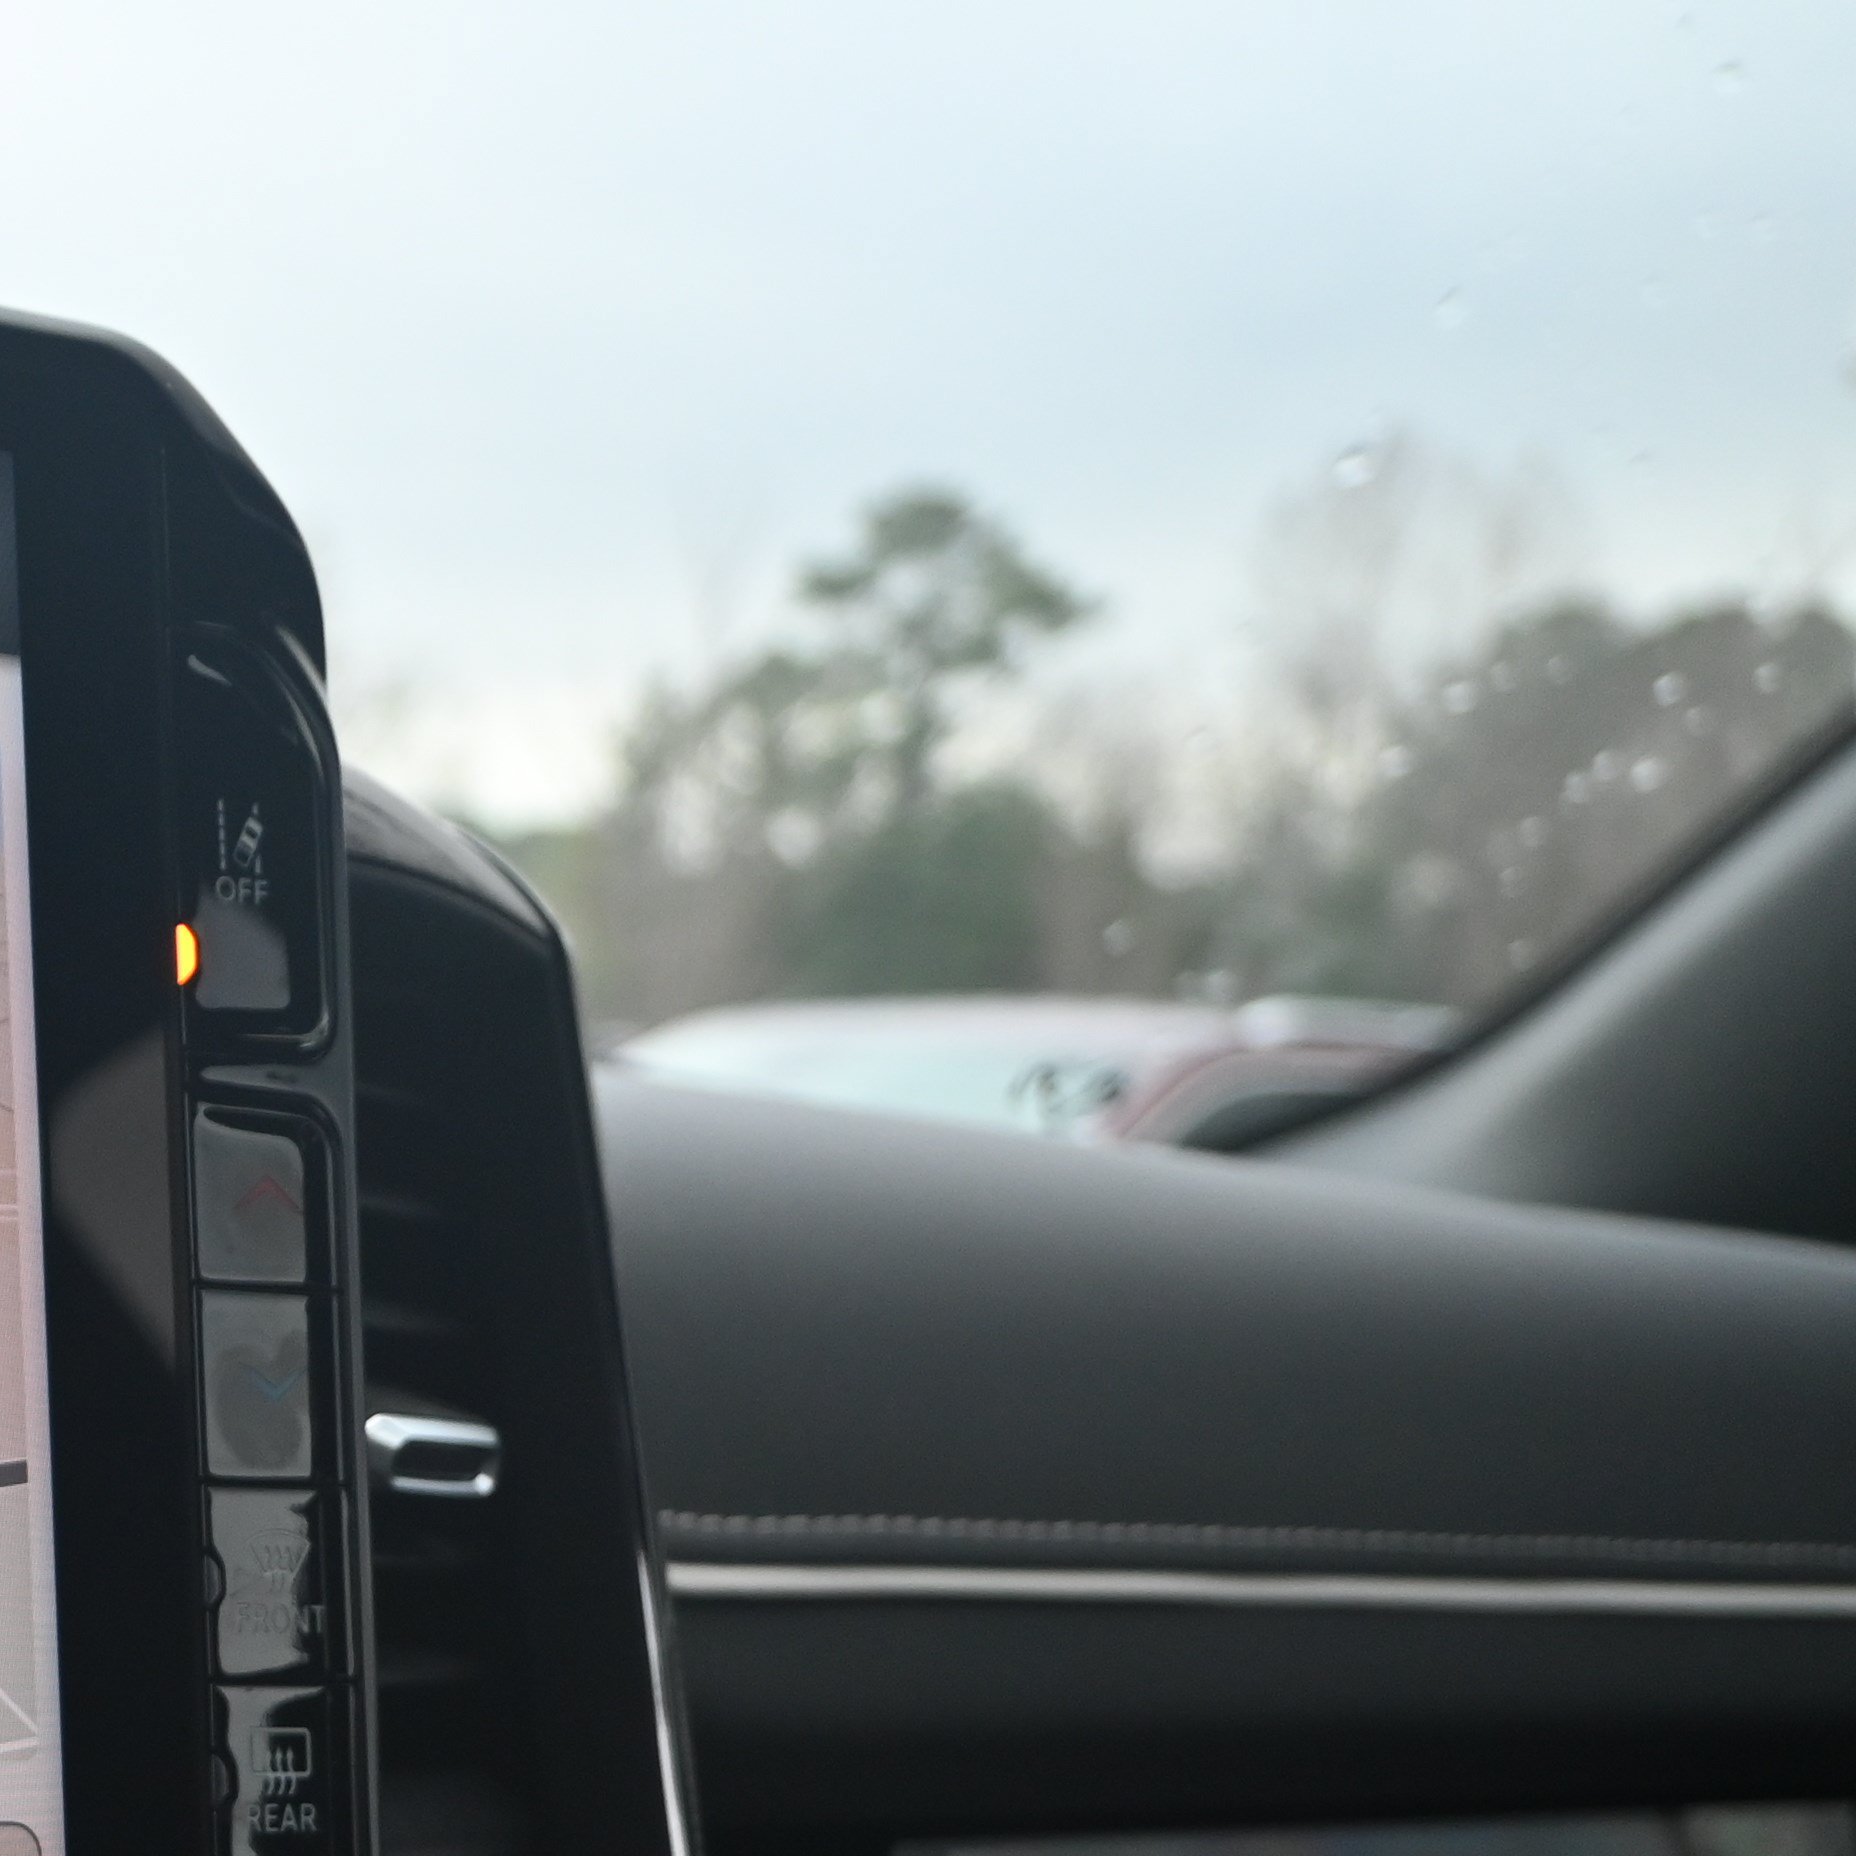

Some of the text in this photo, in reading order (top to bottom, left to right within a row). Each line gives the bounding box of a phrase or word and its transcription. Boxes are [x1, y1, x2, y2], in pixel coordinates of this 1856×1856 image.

[214, 875, 269, 905] OFF
[237, 1602, 325, 1634] FRONT
[247, 1803, 318, 1834] REAR
